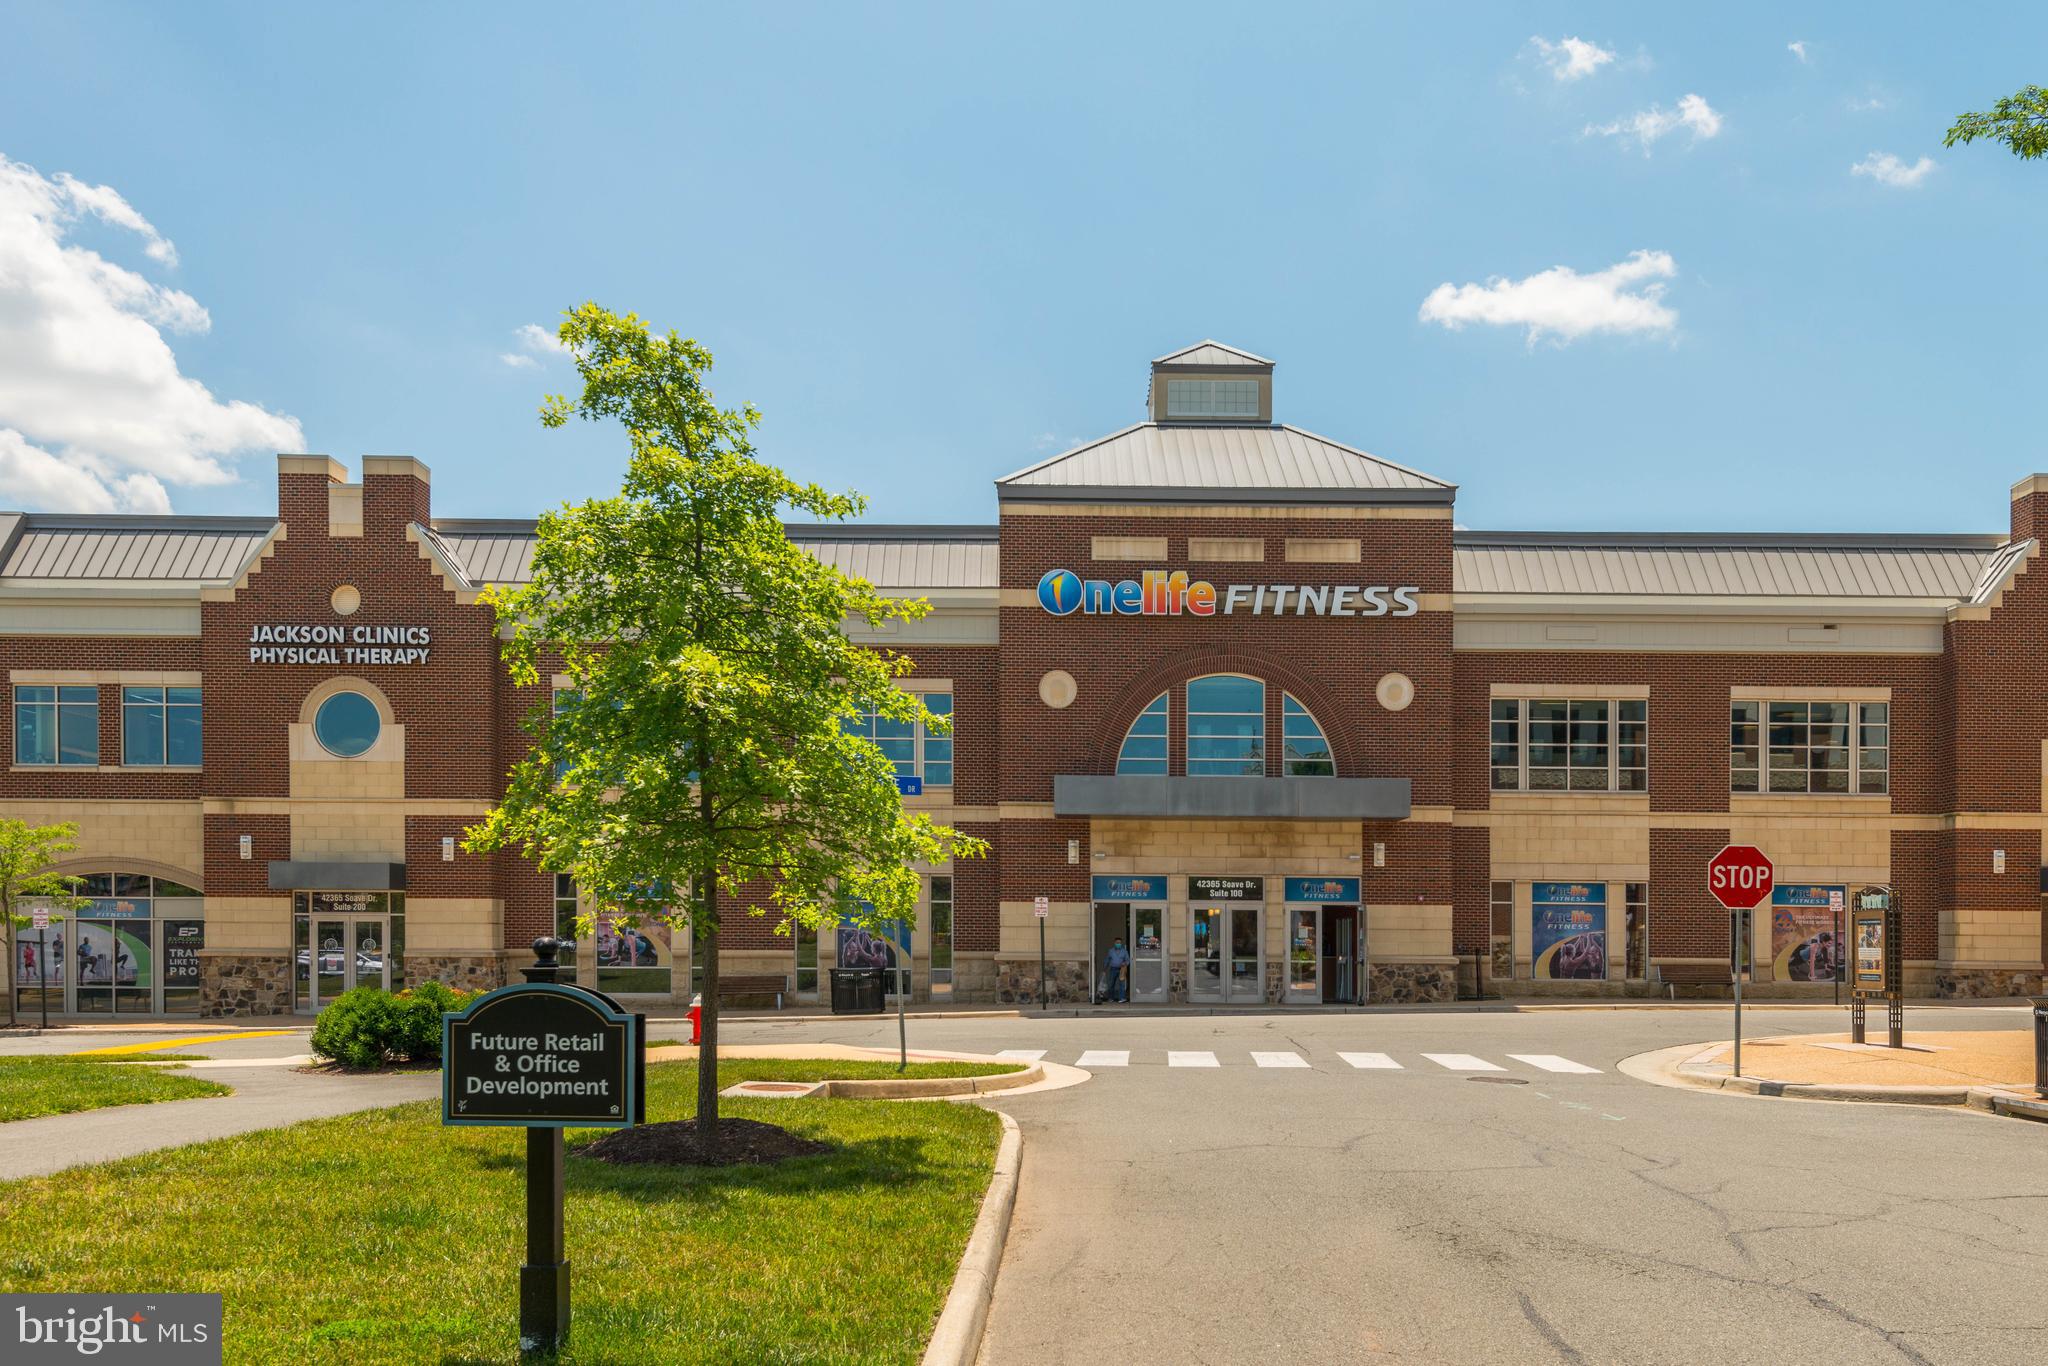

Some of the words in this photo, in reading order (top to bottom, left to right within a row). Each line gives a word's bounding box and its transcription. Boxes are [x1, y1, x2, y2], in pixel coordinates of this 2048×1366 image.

[1036, 568, 1217, 617] Onelife
[1223, 584, 1420, 617] FITNESS
[249, 625, 345, 644] JACKSON
[352, 626, 431, 645] CLINICS
[249, 647, 341, 664] PHYSICAL
[344, 648, 431, 665] THERAPY
[1196, 880, 1221, 888] 42365
[1221, 880, 1244, 888] Soave
[1245, 881, 1257, 889] Dr.
[1713, 864, 1770, 889] STOP
[321, 894, 344, 902] 42365
[1209, 889, 1229, 897] Suite
[1230, 889, 1243, 897] 100
[333, 903, 352, 911] Suite
[352, 903, 366, 911] 200
[178, 927, 199, 937] EP
[470, 1032, 539, 1051] Future
[544, 1033, 605, 1052] Retail
[494, 1055, 511, 1073] &
[517, 1054, 580, 1073] Office
[466, 1076, 609, 1100] Development
